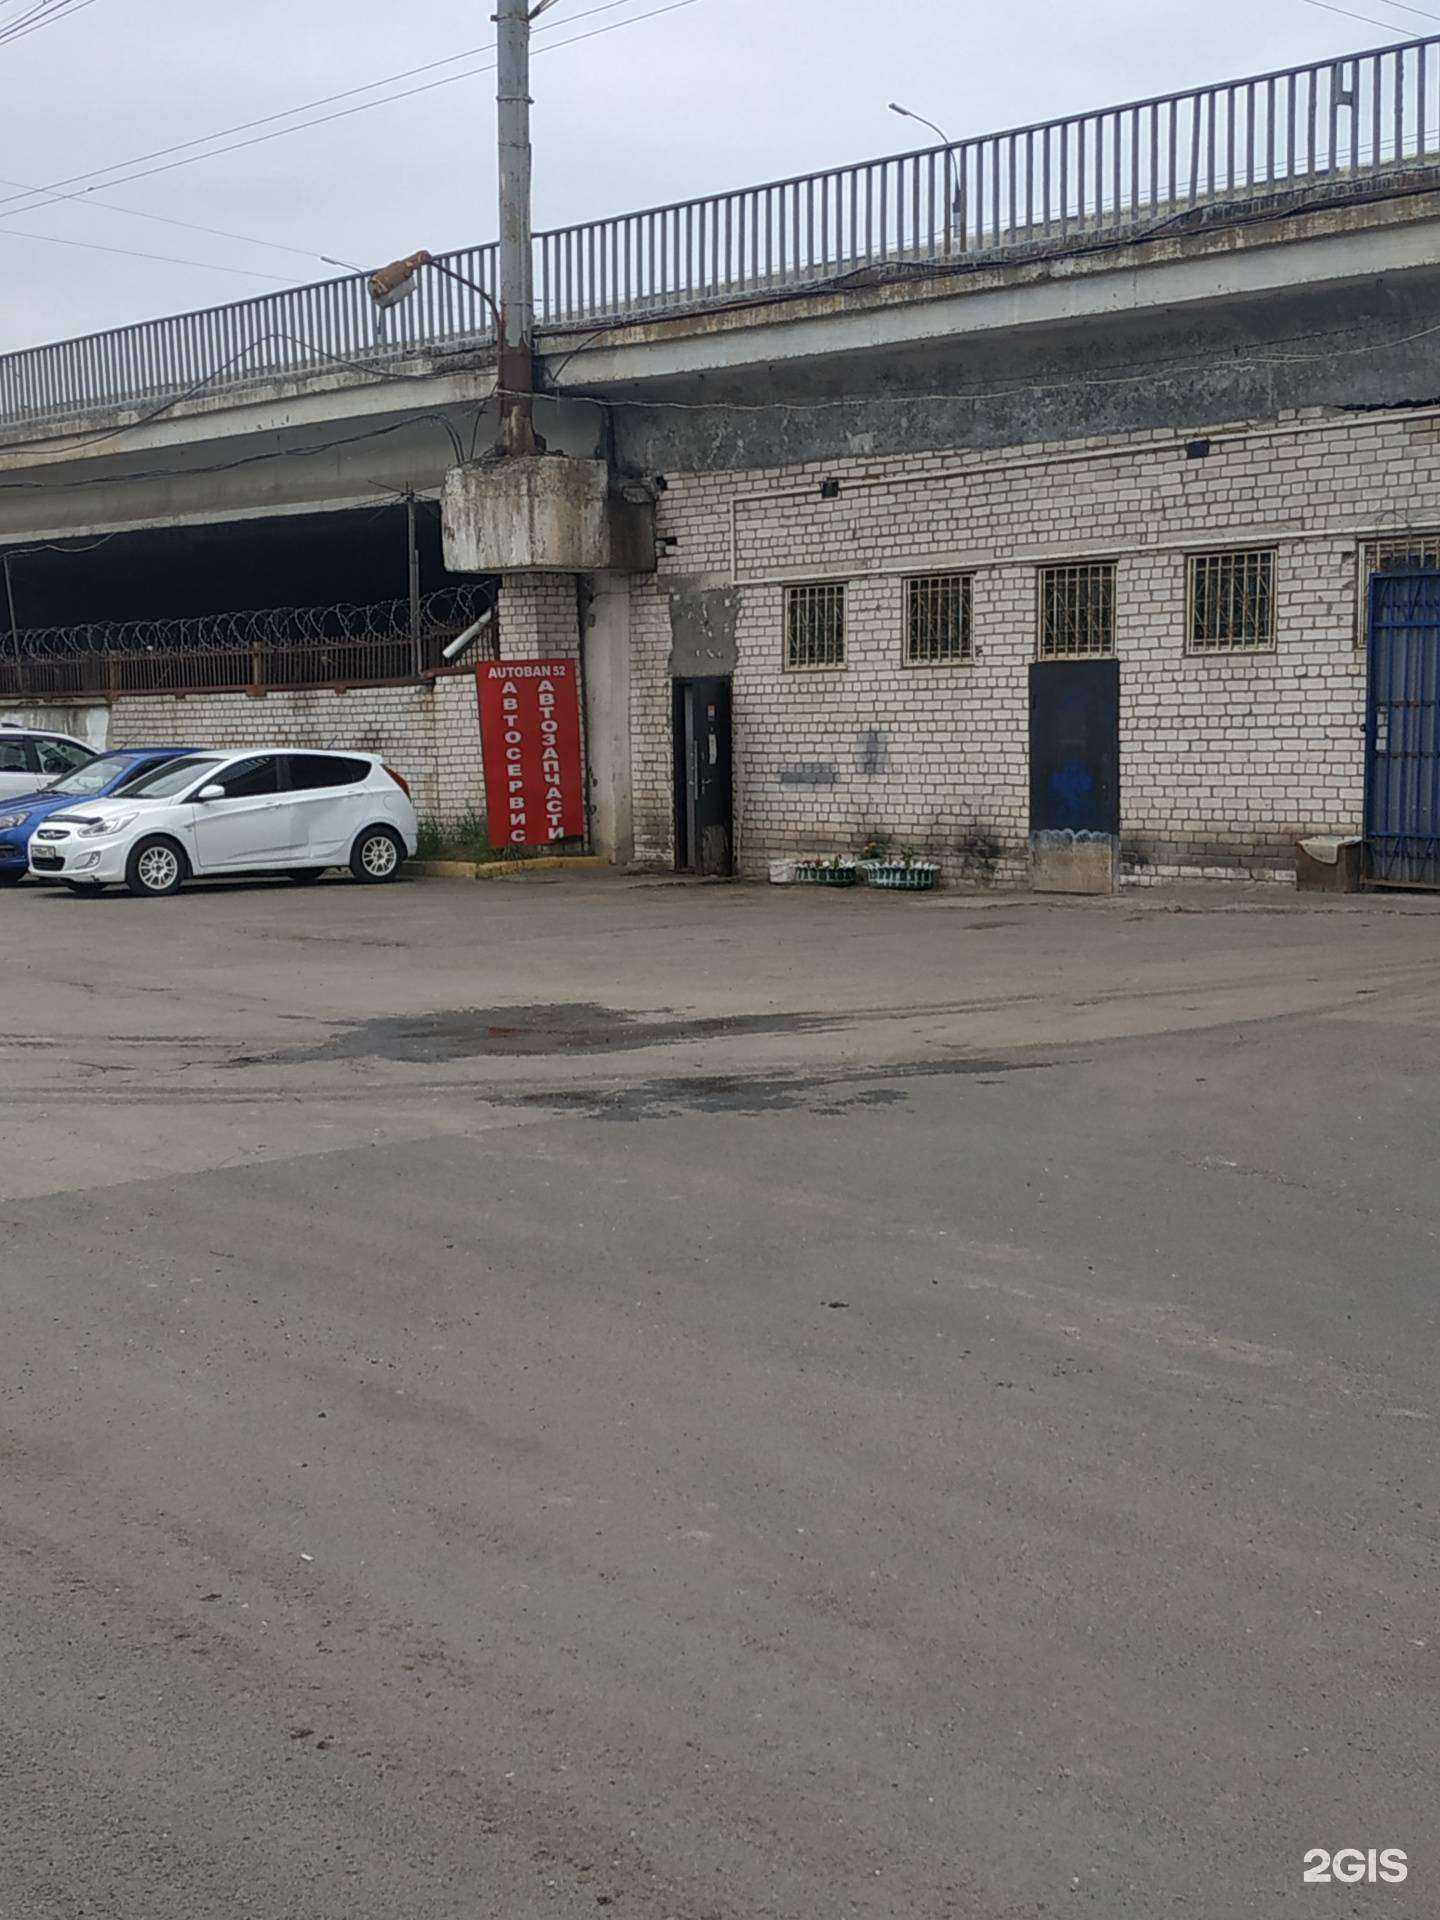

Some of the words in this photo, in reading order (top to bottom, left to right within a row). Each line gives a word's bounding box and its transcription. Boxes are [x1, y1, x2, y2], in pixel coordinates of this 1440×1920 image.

[487, 666, 551, 679] AUTOBAN
[552, 665, 566, 676] 52
[501, 681, 527, 842] АВТОСЕРВИС
[537, 680, 565, 840] АВТОЗАПЧАСТИ
